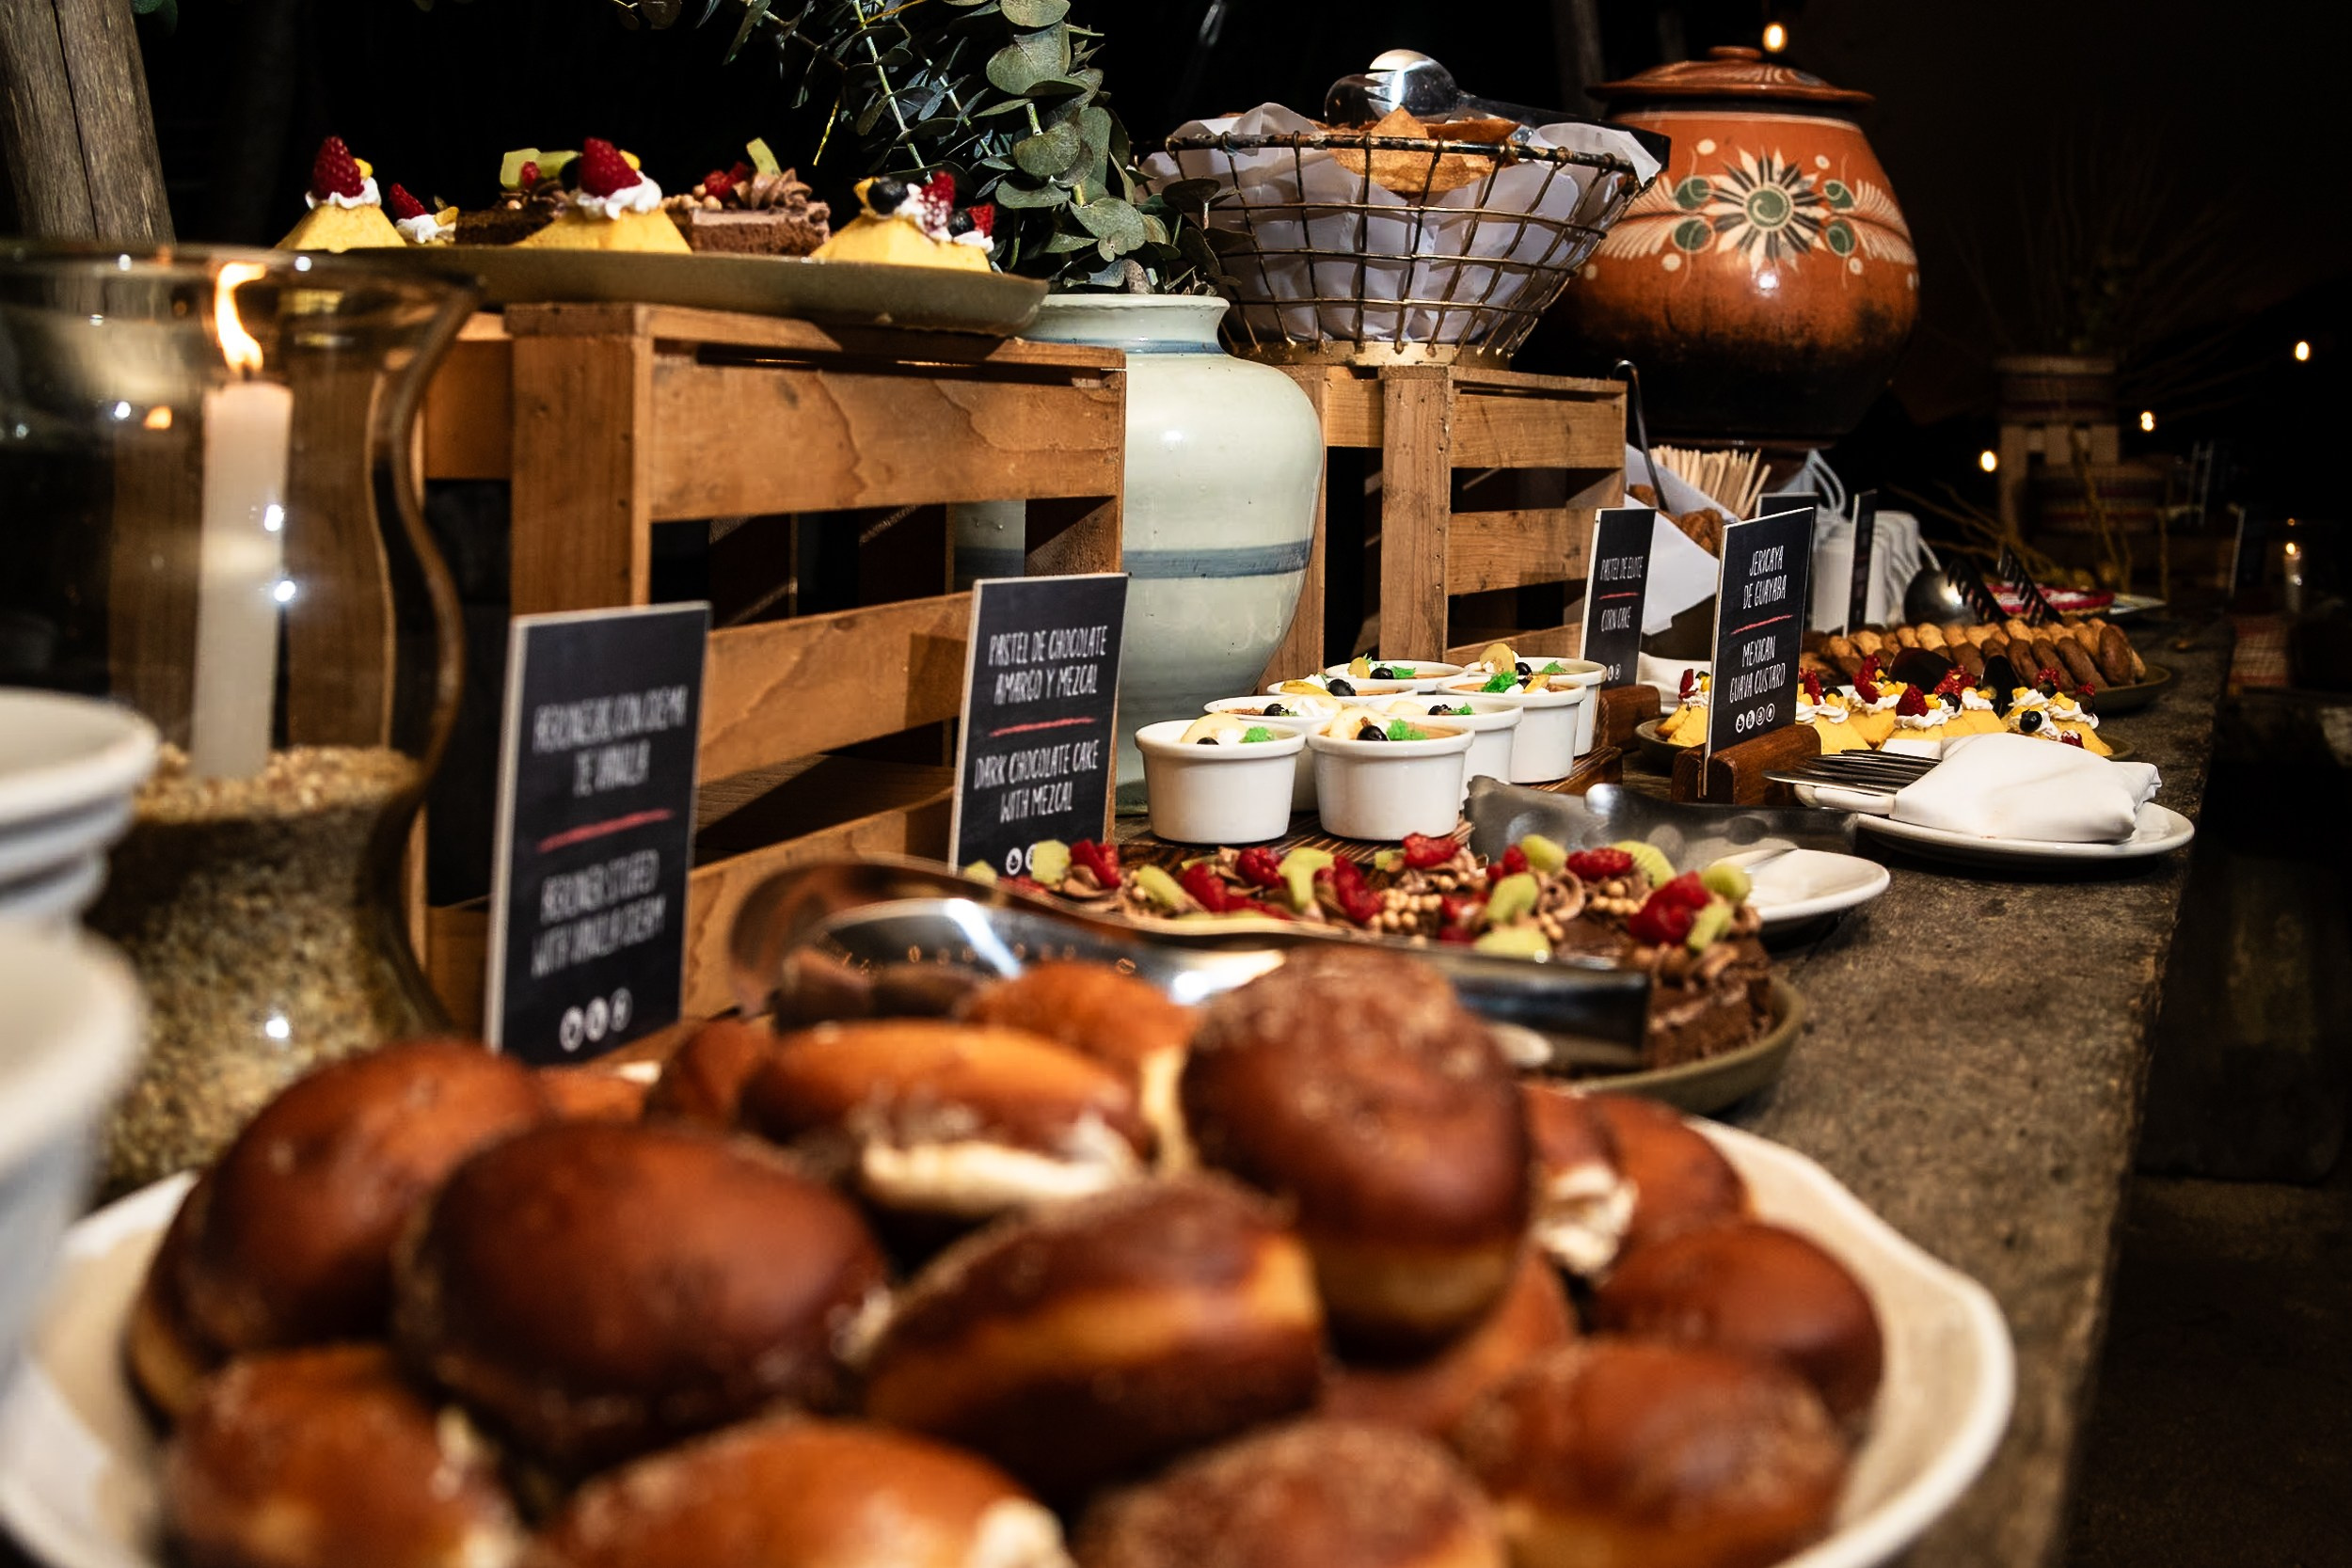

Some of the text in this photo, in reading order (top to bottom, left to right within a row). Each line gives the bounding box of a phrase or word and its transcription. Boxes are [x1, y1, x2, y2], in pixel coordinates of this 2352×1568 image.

[1749, 545, 1784, 577] JERICAYA
[1742, 574, 1788, 610] DE GUAYABA
[988, 625, 1107, 667] PASTEL DE CHOCOLATE
[1741, 635, 1776, 668] MEXICAN
[993, 663, 1098, 705] AMARGO Y MEZCAL
[1729, 662, 1786, 704] GUAVA CUSTARD
[974, 738, 1100, 789] DARK CHOCOLATE CAKE
[1000, 781, 1073, 824] WITH MEZCAL
